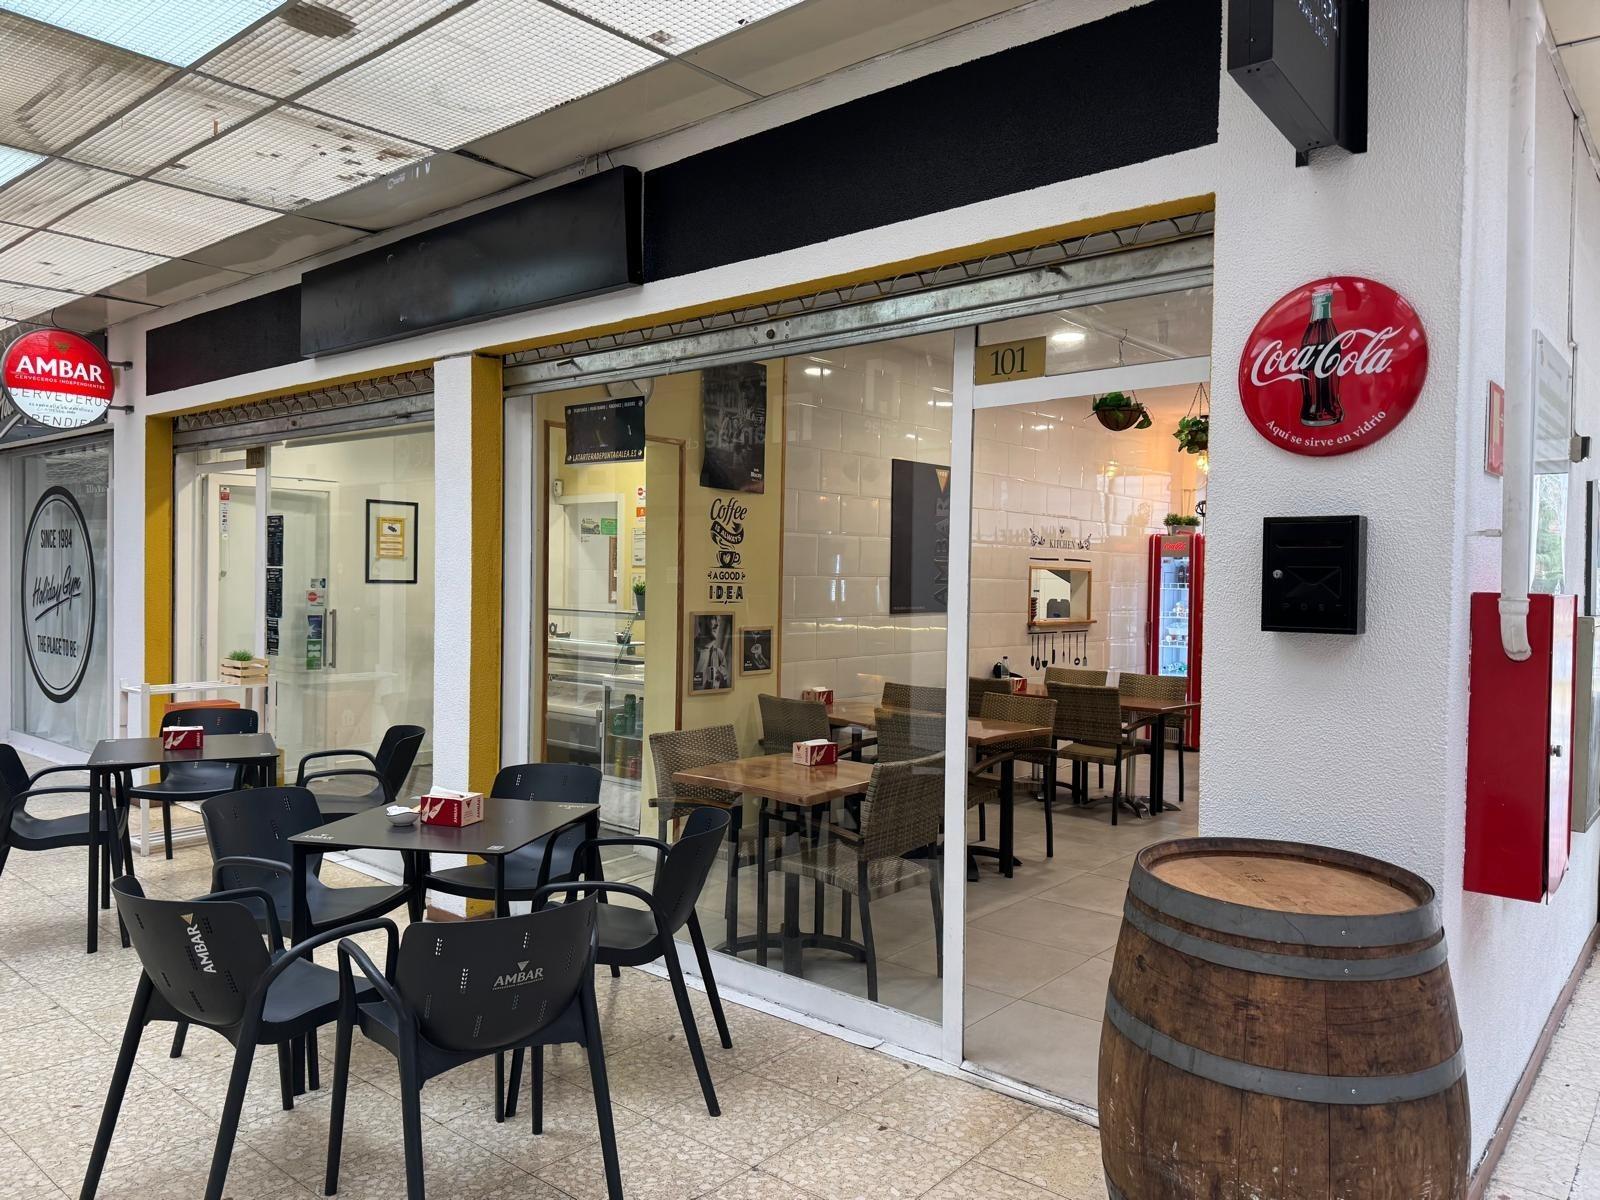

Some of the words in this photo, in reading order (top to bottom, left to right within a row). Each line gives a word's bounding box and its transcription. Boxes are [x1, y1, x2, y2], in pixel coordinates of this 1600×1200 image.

[15, 355, 105, 384] AMBAR
[990, 345, 1029, 377] 101
[1251, 326, 1404, 387] Coca-Cola
[14, 373, 58, 384] CERVECEROS
[59, 379, 106, 391] INDEPENDIENTES
[1265, 419, 1291, 440] Aquí
[1291, 434, 1303, 445] se
[1304, 437, 1334, 447] sirve
[1336, 434, 1352, 445] en
[1352, 410, 1387, 438] vidrio
[711, 497, 748, 526] Coffee
[40, 529, 57, 549] SINCE
[58, 528, 73, 549] 1984
[714, 523, 721, 533] IS
[720, 530, 743, 544] ALWAYS
[1049, 539, 1076, 550] KITCHEN
[932, 497, 950, 605] AMBAR
[32, 573, 62, 617] Holiday
[62, 564, 82, 611] Gym
[713, 571, 719, 580] A
[720, 571, 741, 581] GOOD
[37, 634, 47, 653] THE
[46, 635, 62, 656] PLACE
[61, 637, 70, 657] TO
[69, 640, 77, 658] BE
[186, 923, 217, 974] AMBAR
[493, 967, 544, 988] AMBAR
